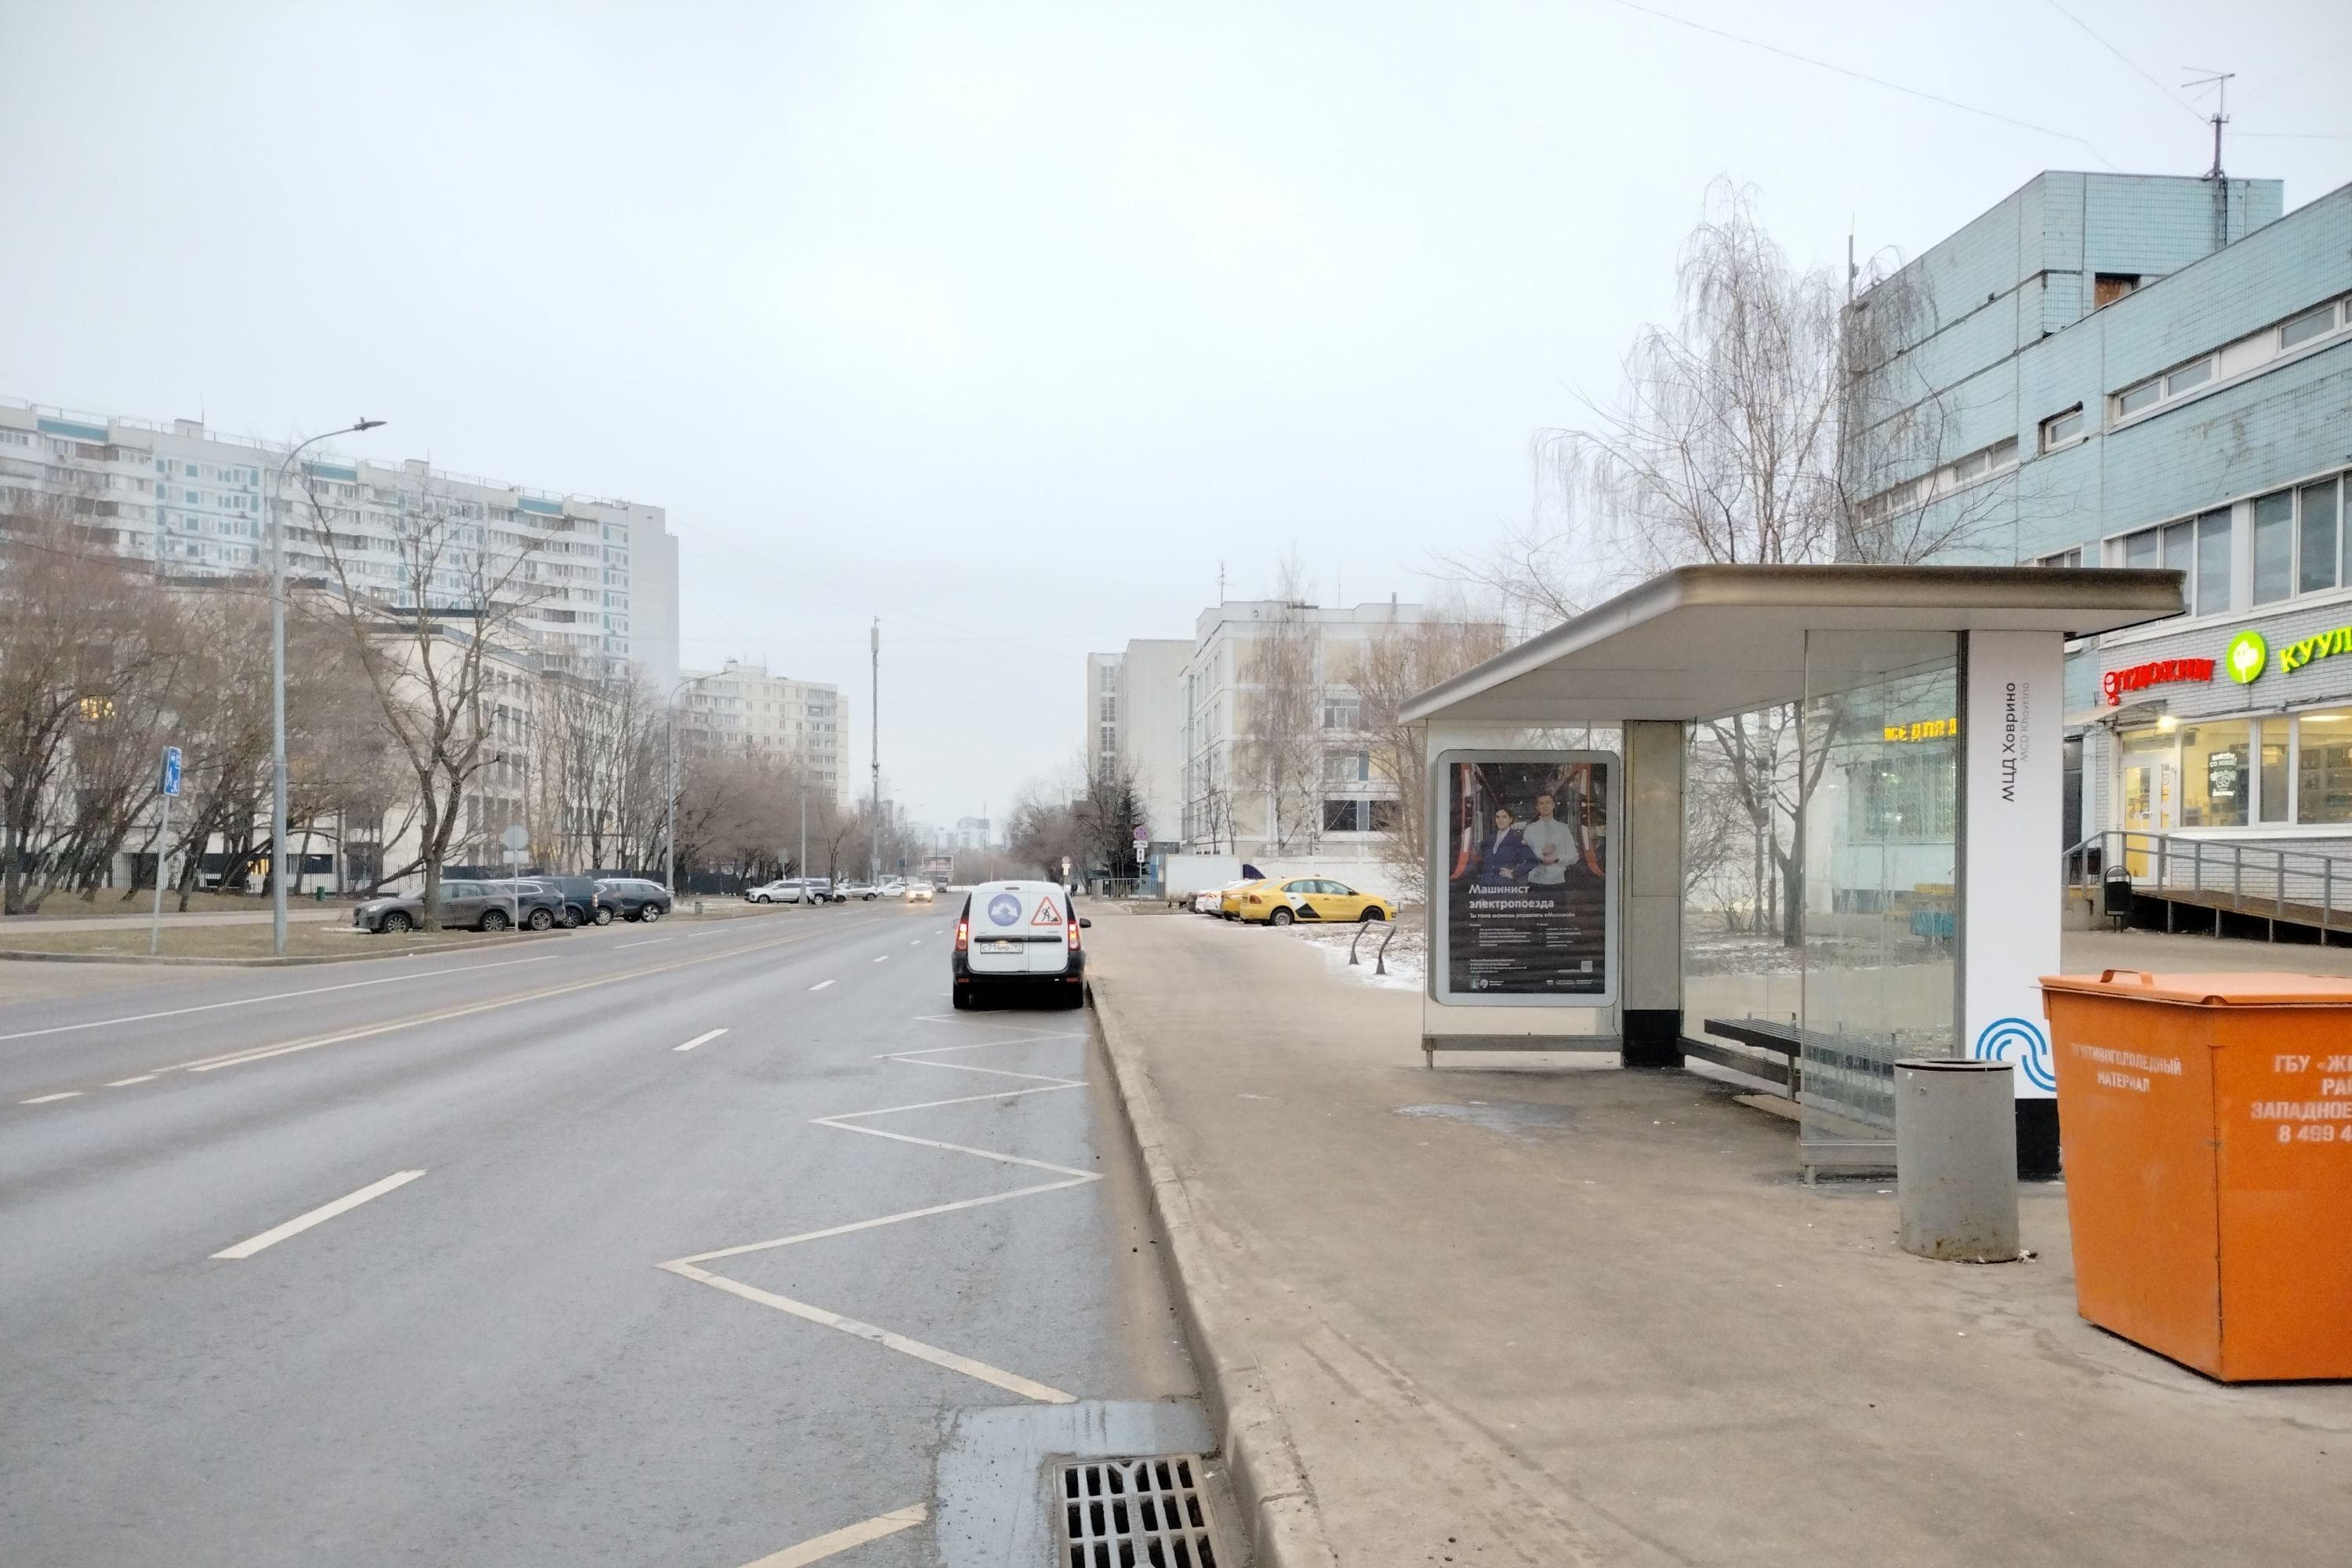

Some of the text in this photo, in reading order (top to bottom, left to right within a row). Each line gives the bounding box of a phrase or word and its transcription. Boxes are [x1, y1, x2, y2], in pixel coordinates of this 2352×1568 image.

[2020, 682, 2030, 762] MCD Khovrino
[2002, 682, 2018, 803] МЦД Ховрино
[1468, 884, 1530, 895] Машинист
[1468, 900, 1555, 910] электропоезда
[2274, 1054, 2311, 1073] ГБУ
[2096, 1070, 2151, 1093] МАТЕРИАЛ
[2249, 1101, 2352, 1122] ЗАПАДНОЕ
[2278, 1124, 2291, 1142] 8
